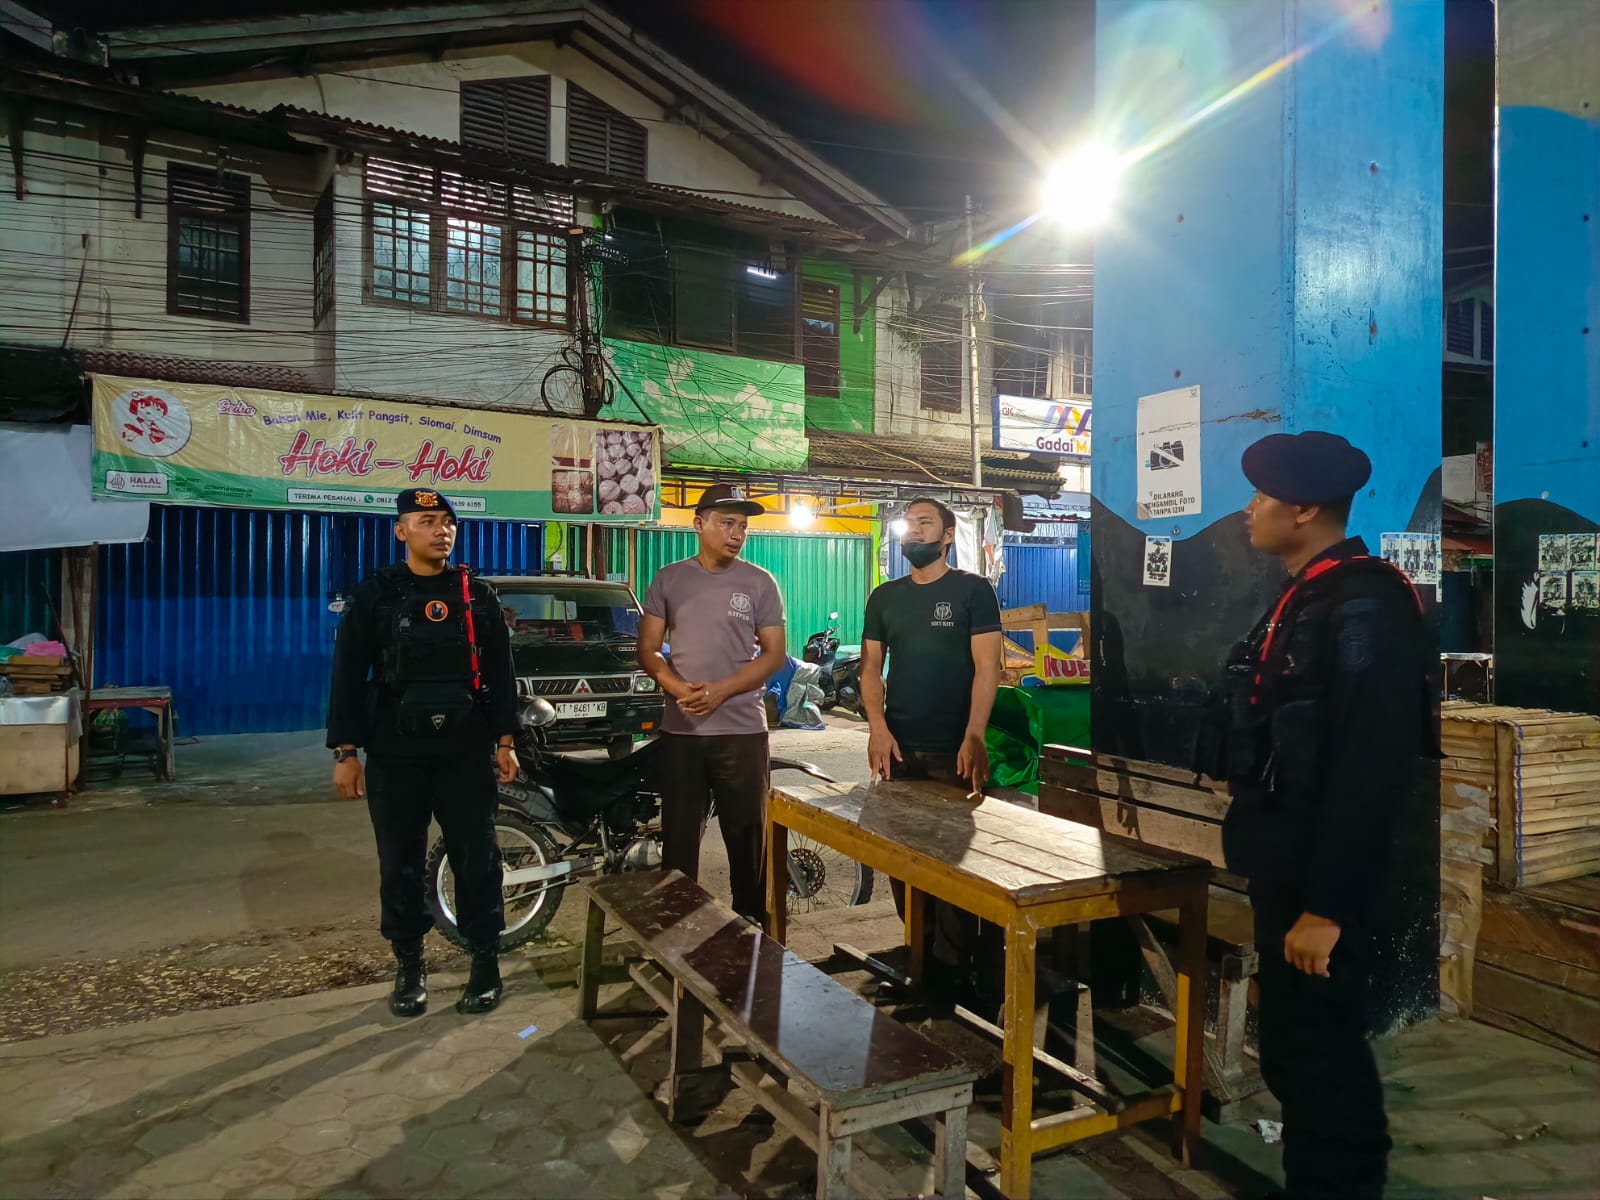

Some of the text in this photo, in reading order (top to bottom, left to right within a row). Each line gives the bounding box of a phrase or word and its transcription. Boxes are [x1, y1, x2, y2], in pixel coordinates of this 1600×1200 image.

[337, 410, 364, 421] Kulit
[463, 424, 502, 444] Dimsum
[1036, 436, 1073, 453] Gadai
[279, 430, 376, 477] Hoki
[405, 439, 494, 484] Hoki
[130, 477, 161, 485] HALAL
[294, 493, 321, 501] TERIMA
[323, 495, 356, 503] PESANAN
[1153, 490, 1184, 501] DILARANG
[1179, 497, 1196, 505] FOTO
[1153, 507, 1171, 516] TANPA
[1043, 654, 1091, 679] KUE
[557, 702, 606, 714] KT 8461 KB
